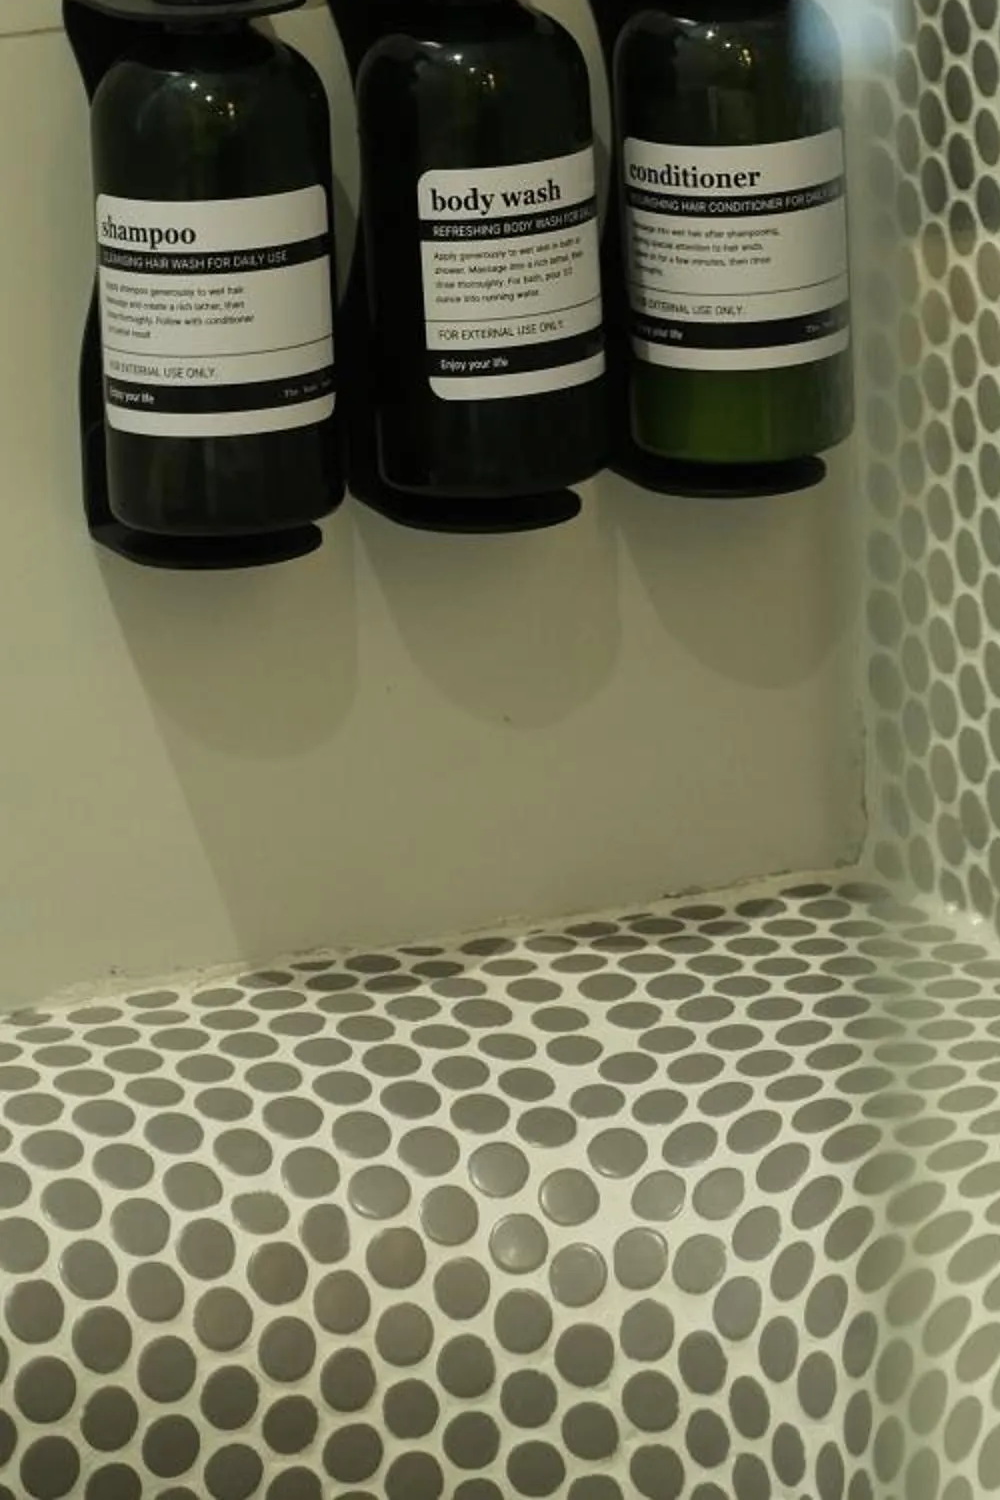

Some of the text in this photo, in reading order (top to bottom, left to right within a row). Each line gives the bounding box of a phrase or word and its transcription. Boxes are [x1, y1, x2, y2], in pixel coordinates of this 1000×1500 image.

[629, 163, 761, 189] conditioner
[430, 179, 561, 215] body wash
[681, 200, 706, 213] HAIR
[708, 197, 783, 214] CONDITIONER
[101, 215, 196, 250] shampoo
[432, 223, 501, 238] REFRESHING
[503, 219, 533, 235] BODY
[535, 213, 563, 229] WASH
[145, 256, 169, 269] HAIR
[172, 257, 204, 270] WASH
[207, 256, 231, 269] FOR
[233, 253, 264, 267] DAILY
[267, 250, 288, 263] USE
[439, 329, 458, 341] FOR
[461, 327, 515, 341] EXTERNAL
[516, 323, 537, 336] USE
[163, 367, 183, 379] USE
[440, 358, 467, 372] Enjoy
[467, 359, 491, 372] your
